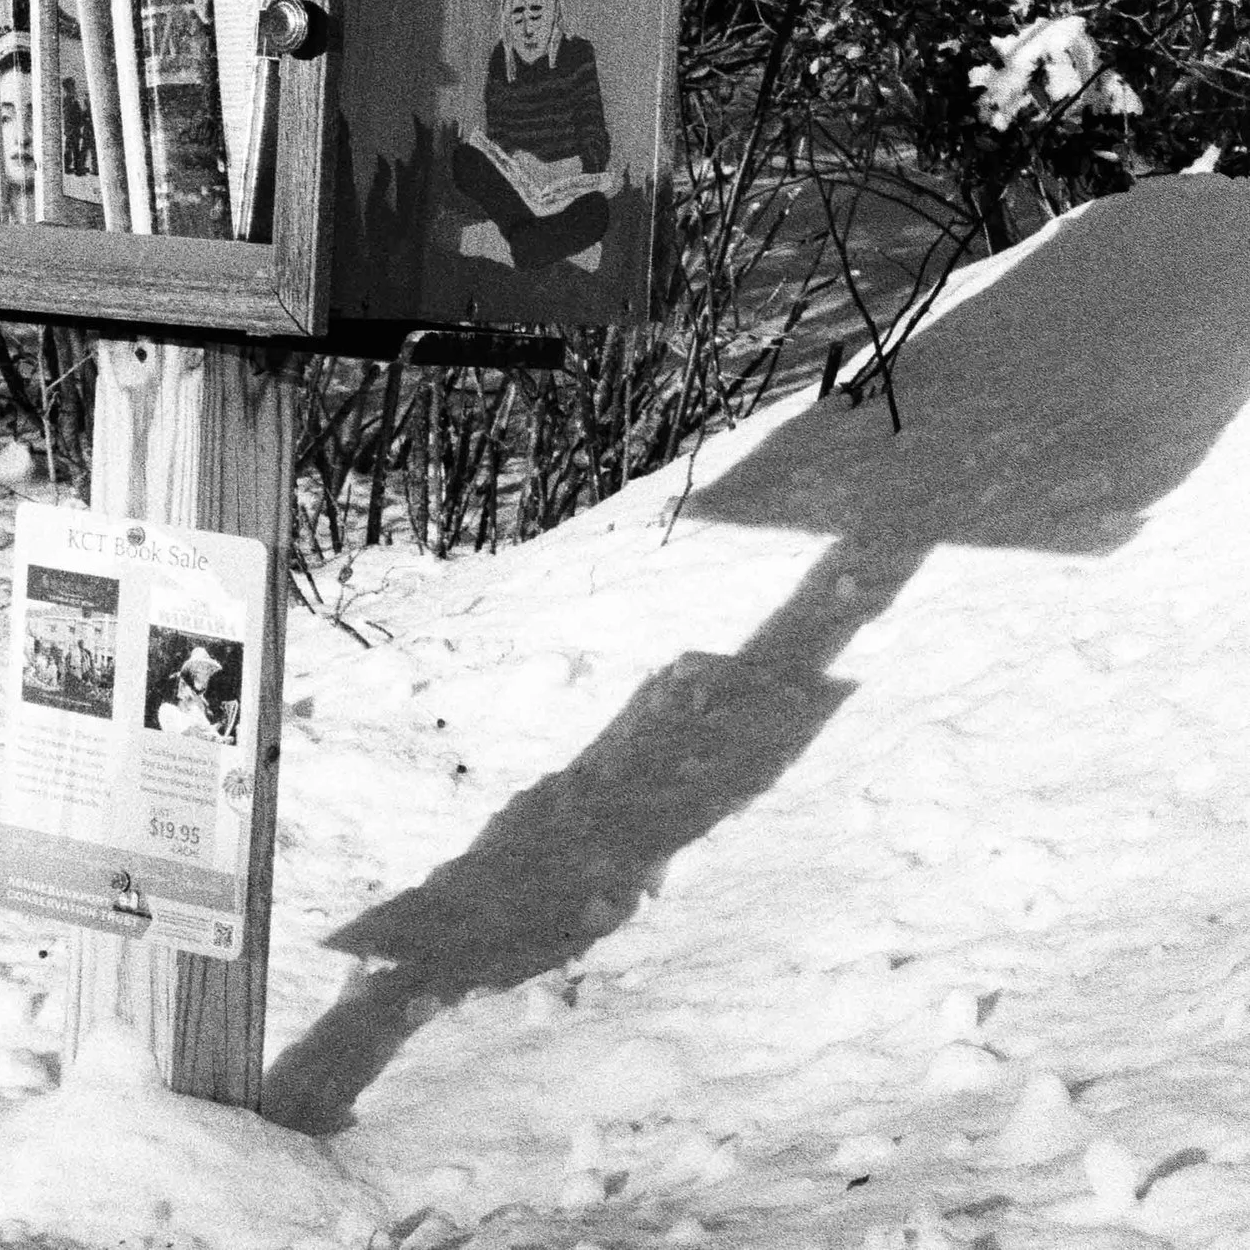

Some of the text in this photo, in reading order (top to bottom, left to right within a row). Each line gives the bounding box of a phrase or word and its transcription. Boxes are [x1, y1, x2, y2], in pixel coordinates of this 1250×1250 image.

[67, 528, 209, 572] KCT Book Sale
[149, 816, 200, 845] $19.95
